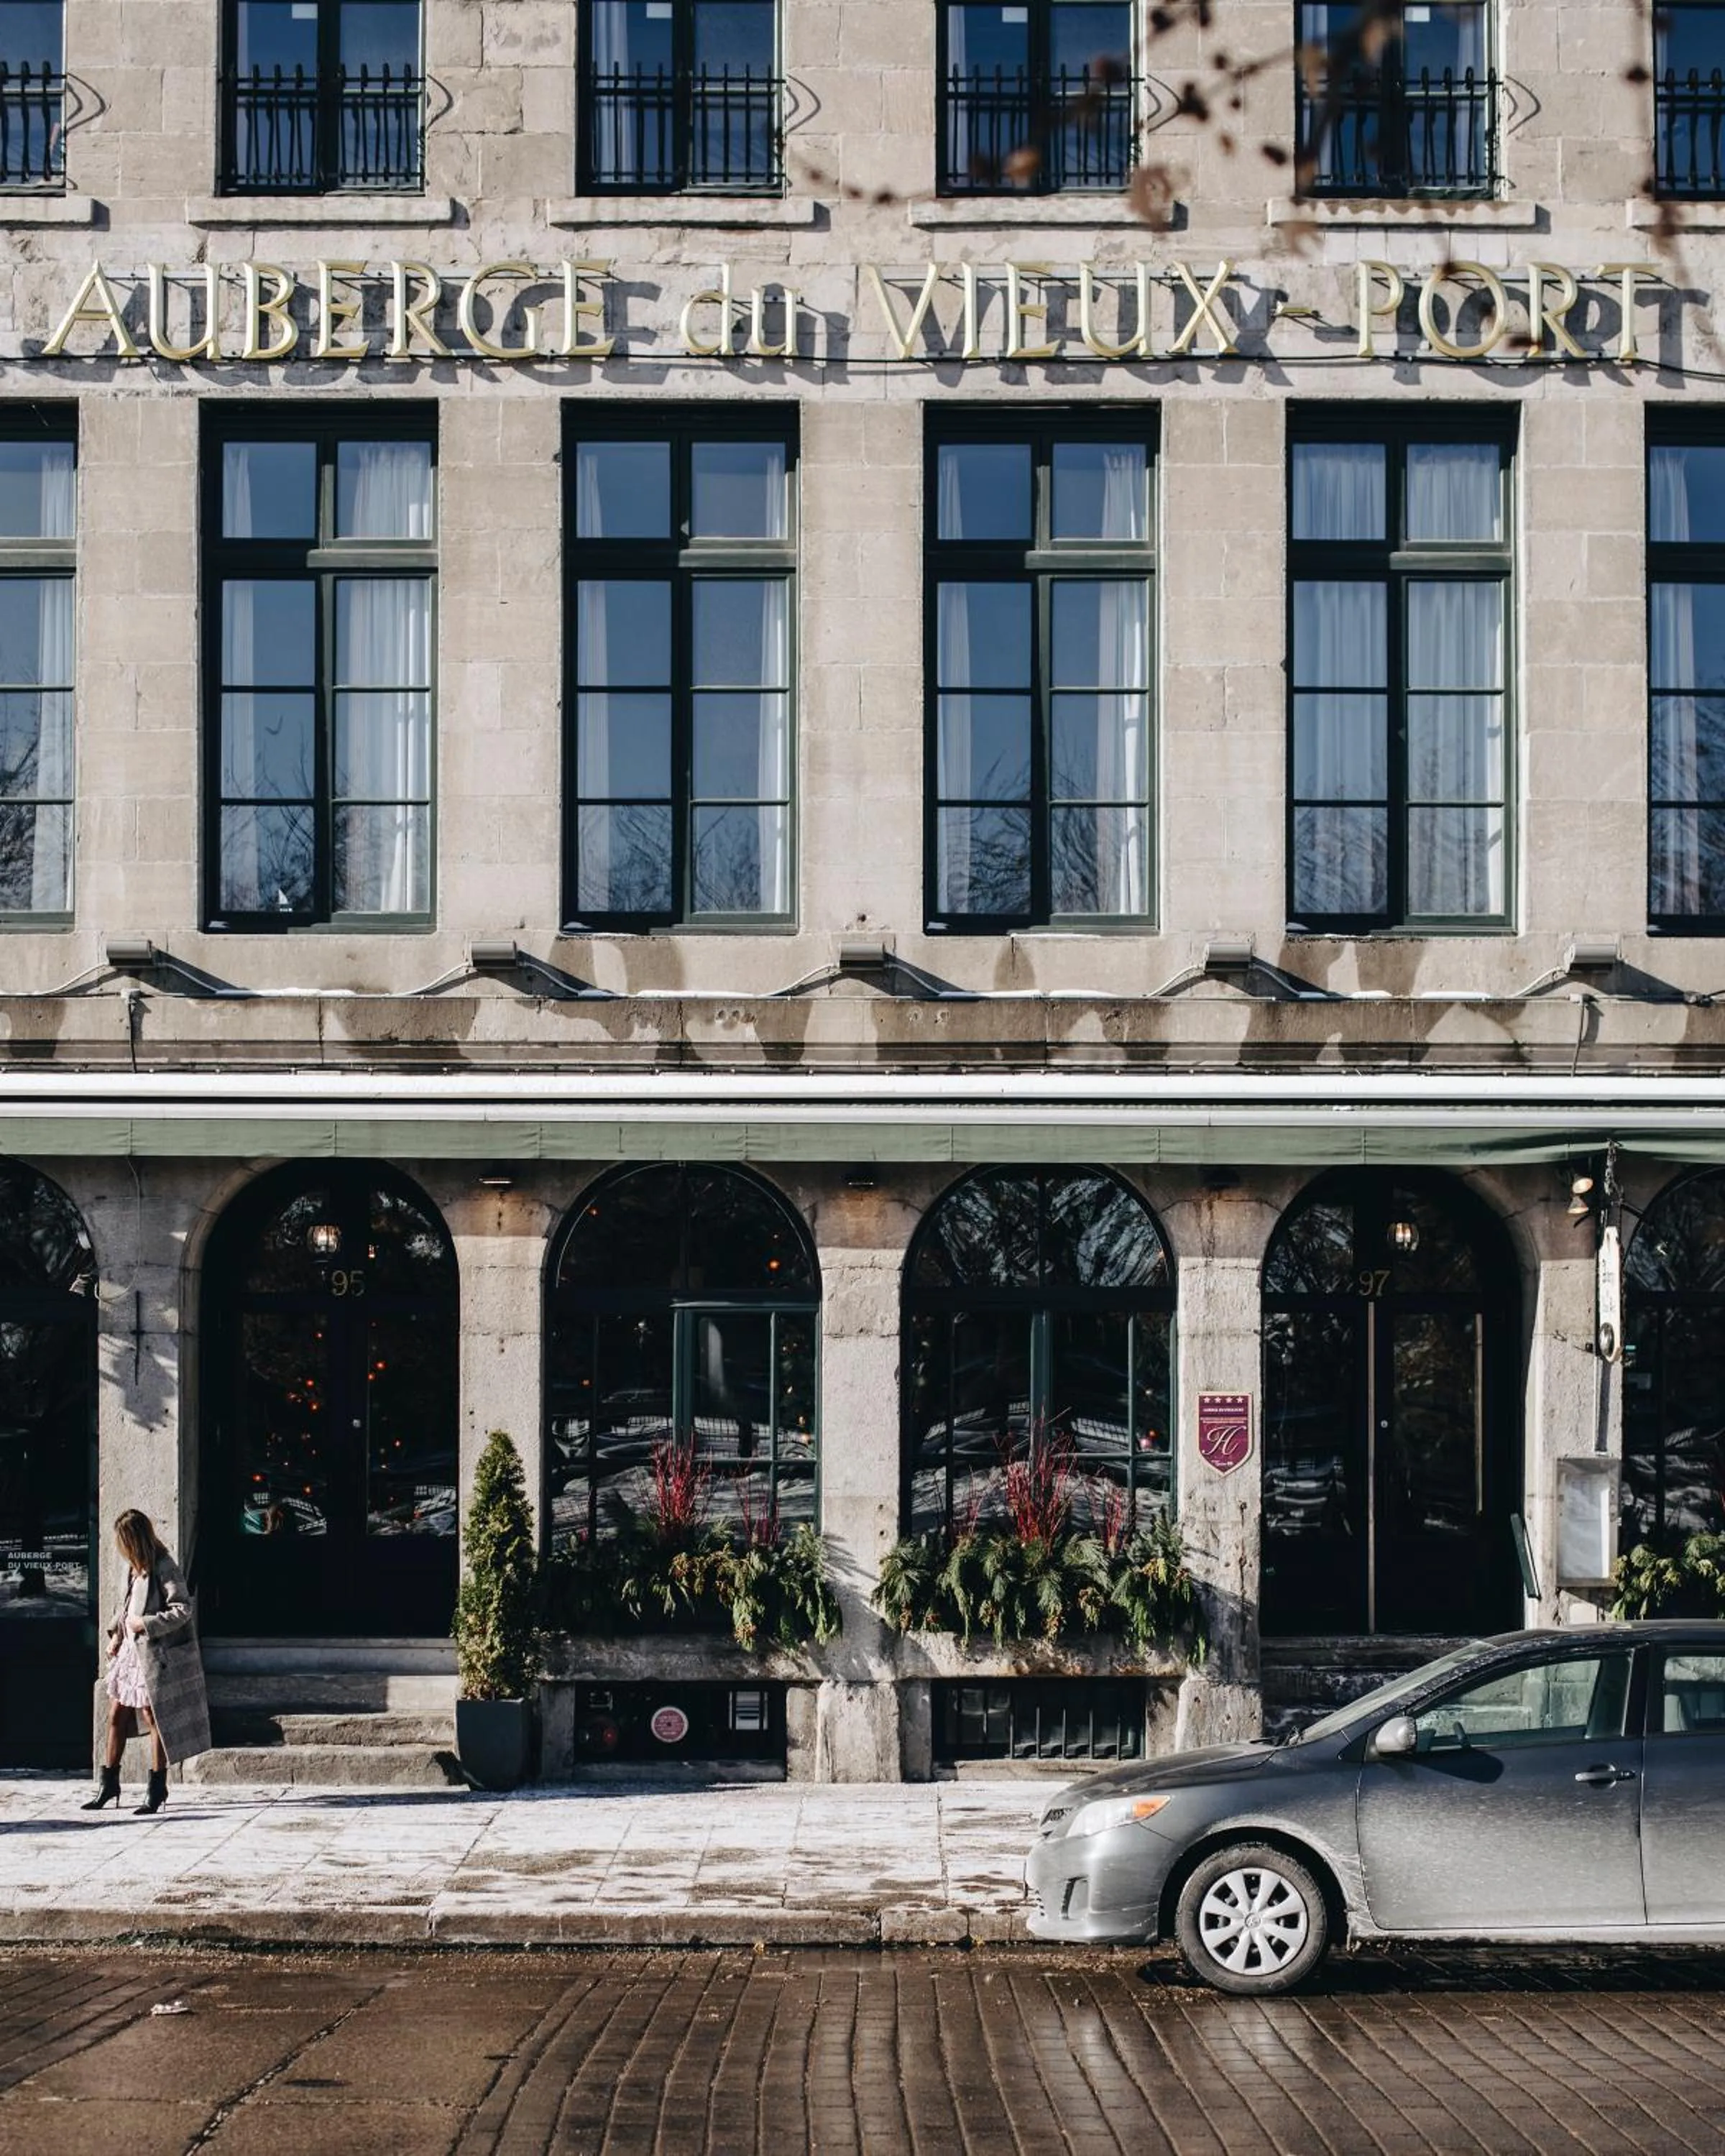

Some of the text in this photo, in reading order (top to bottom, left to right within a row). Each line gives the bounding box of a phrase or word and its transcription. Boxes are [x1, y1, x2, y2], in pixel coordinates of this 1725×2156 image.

[42, 259, 617, 361] AUBERGE
[680, 263, 799, 357] du
[331, 1270, 366, 1296] 95
[1359, 1270, 1391, 1296] 97
